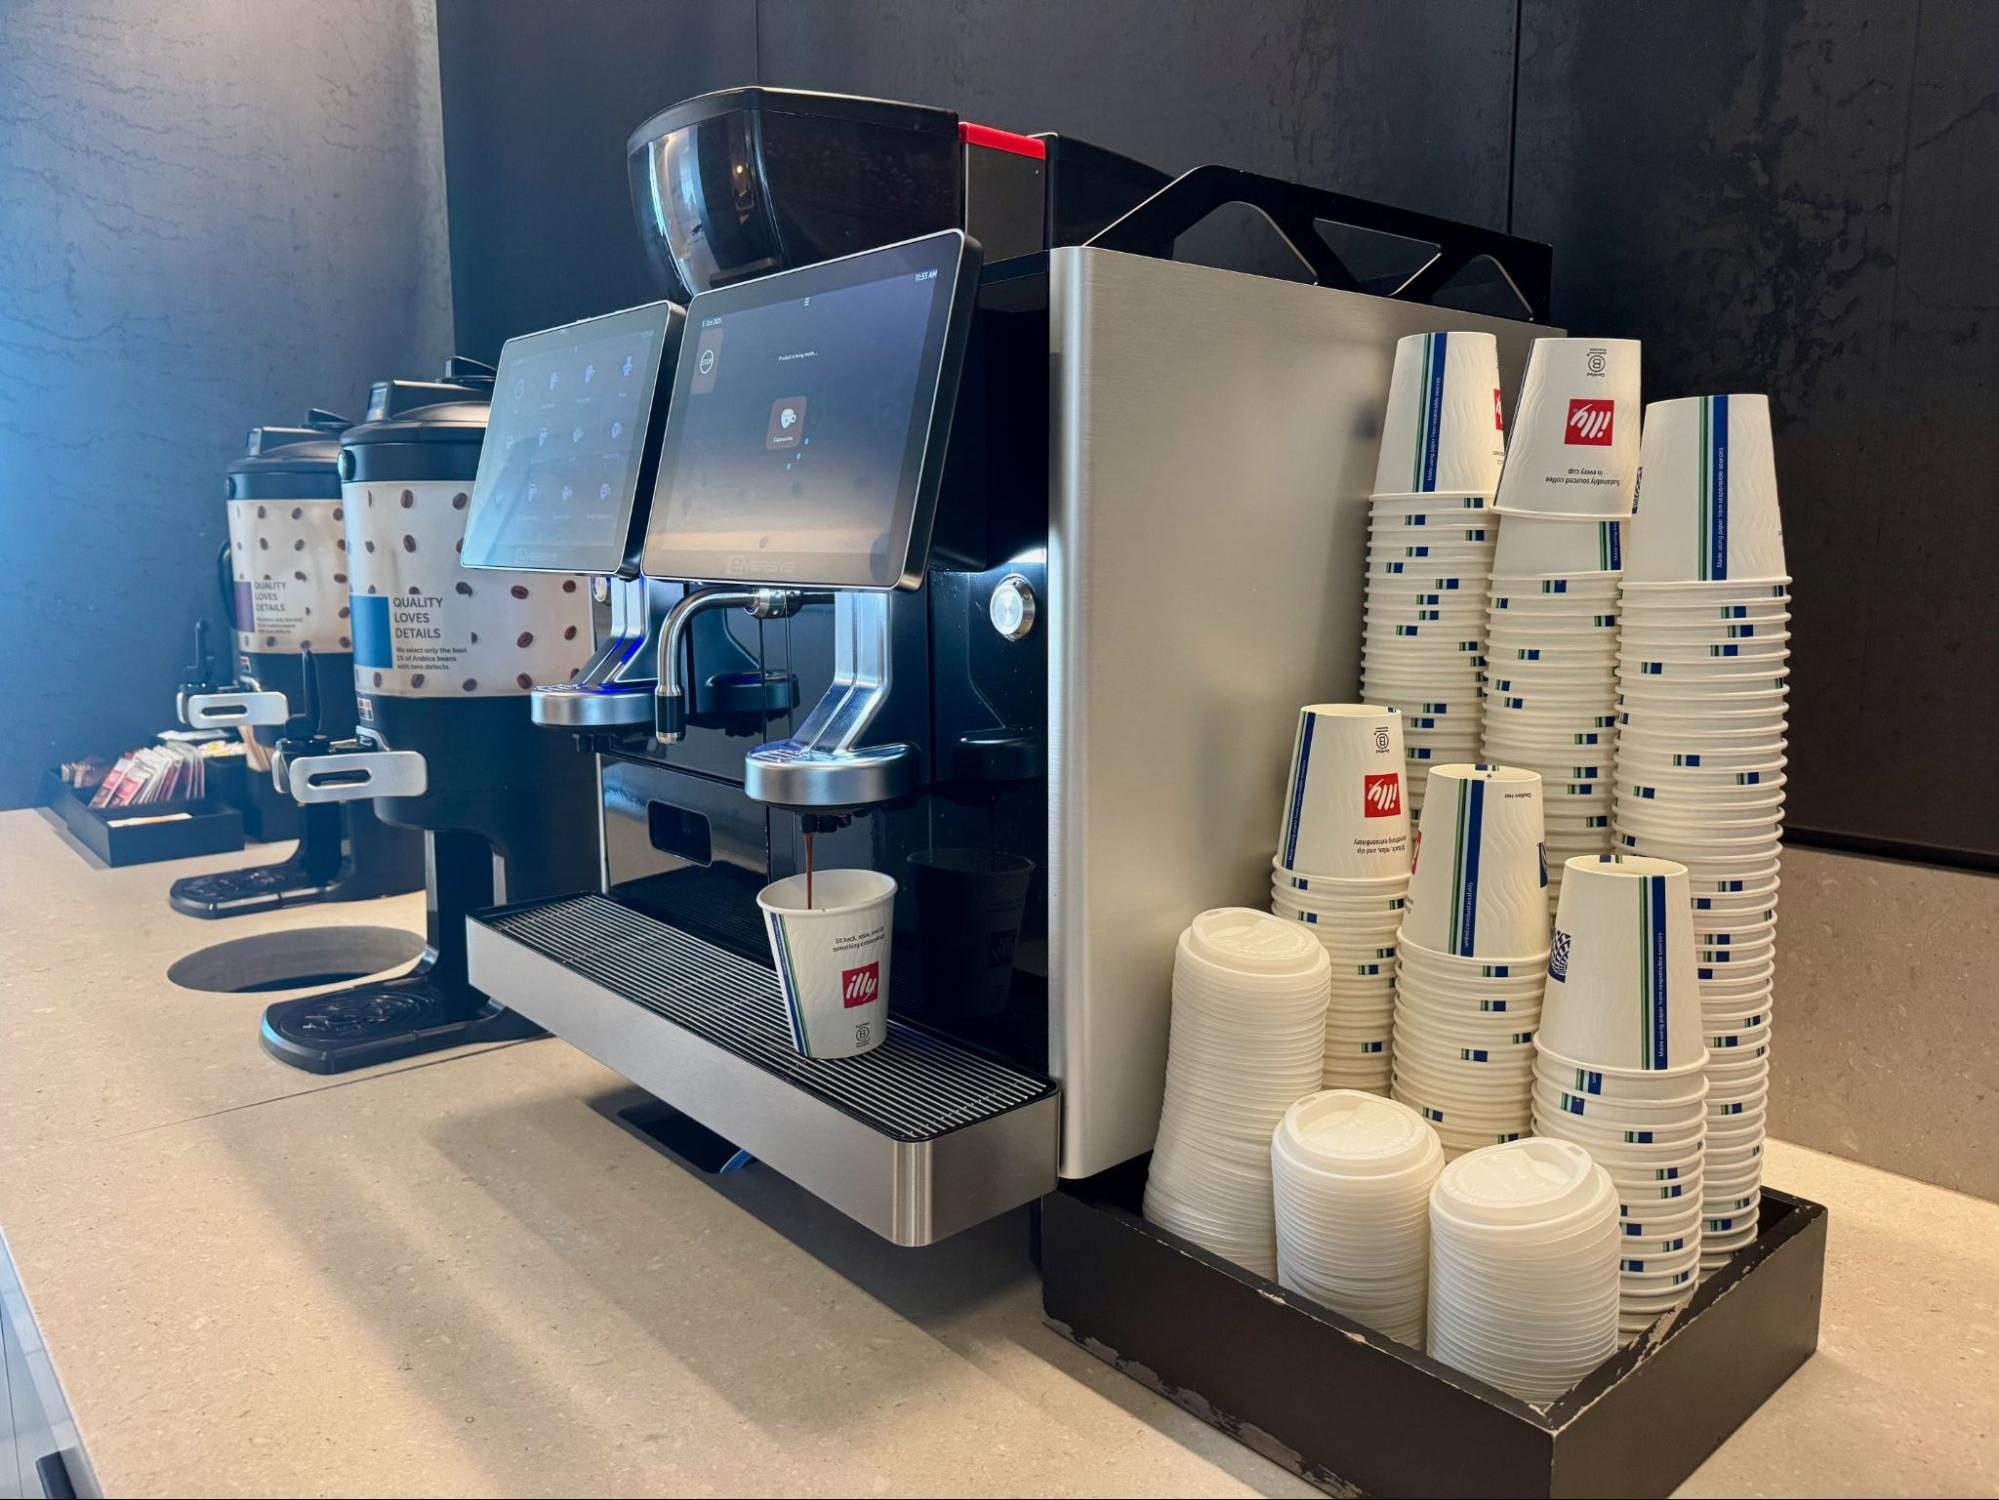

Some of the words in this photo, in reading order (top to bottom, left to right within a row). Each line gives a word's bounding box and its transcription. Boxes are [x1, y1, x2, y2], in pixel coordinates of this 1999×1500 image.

[1570, 403, 1611, 439] illy
[393, 597, 443, 608] QUALITY
[394, 613, 430, 623] LOVES
[395, 628, 441, 639] DETAILS
[1368, 778, 1397, 810] illy
[846, 972, 878, 1001] illy
